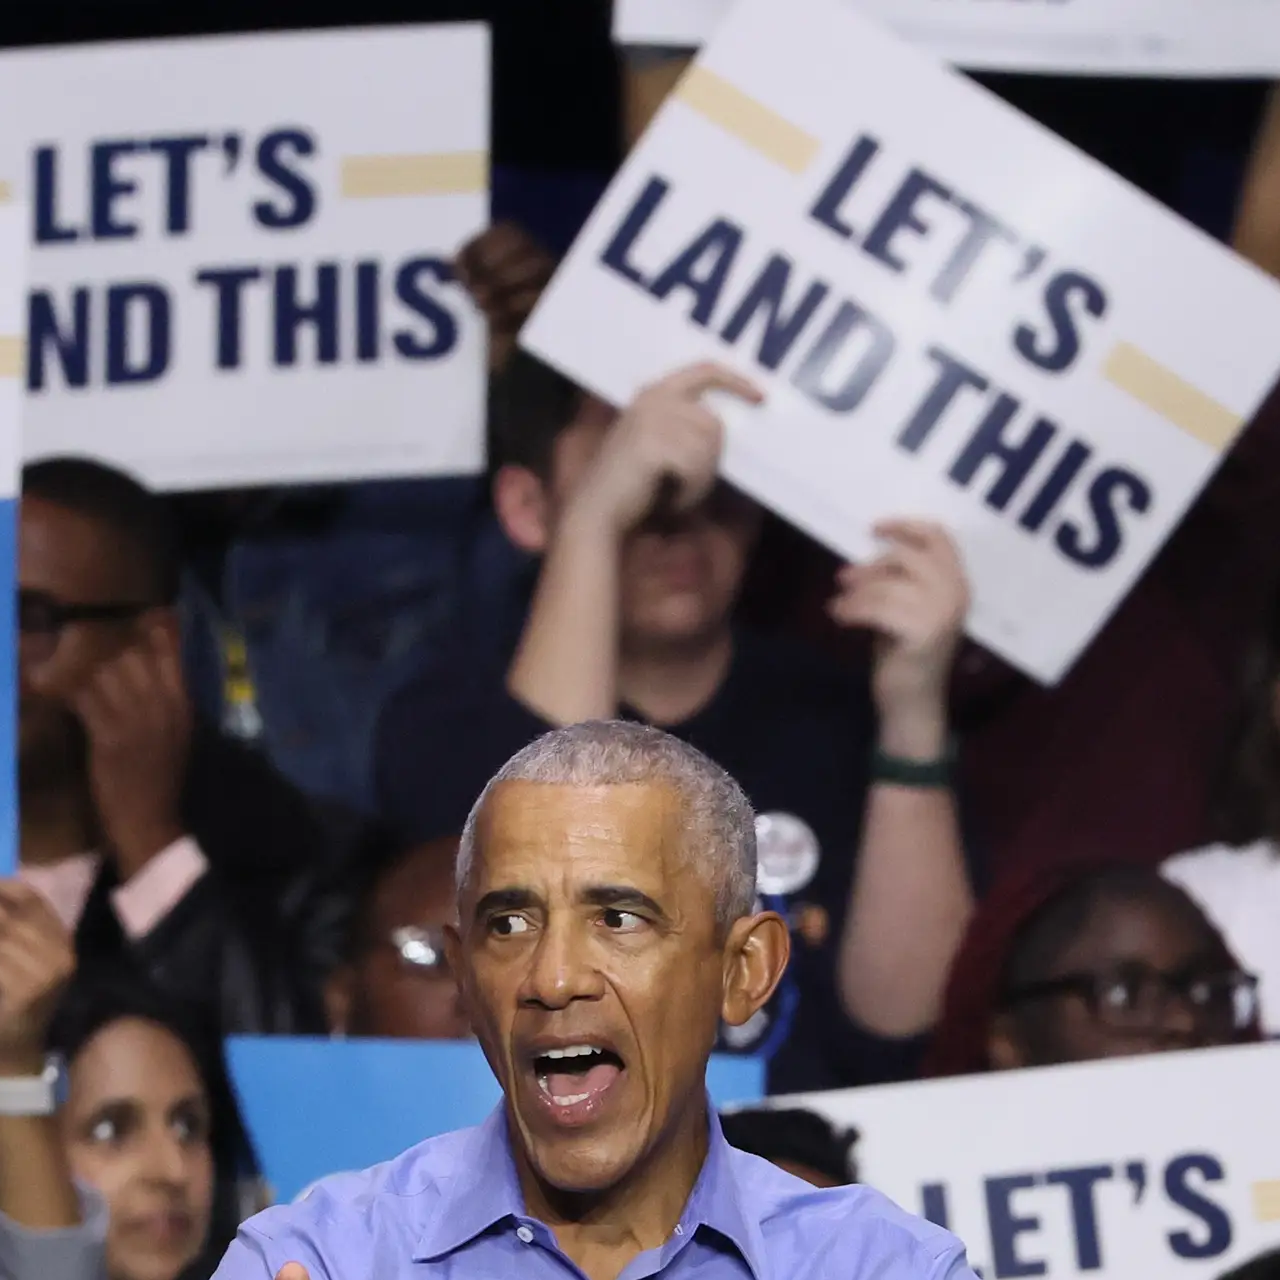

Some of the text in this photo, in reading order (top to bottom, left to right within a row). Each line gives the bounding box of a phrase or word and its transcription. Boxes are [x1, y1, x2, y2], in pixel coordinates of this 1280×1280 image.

[31, 128, 320, 247] LET'S
[810, 132, 1107, 377] LET'S
[25, 255, 462, 394] ND THIS
[599, 174, 1153, 574] LAND THIS
